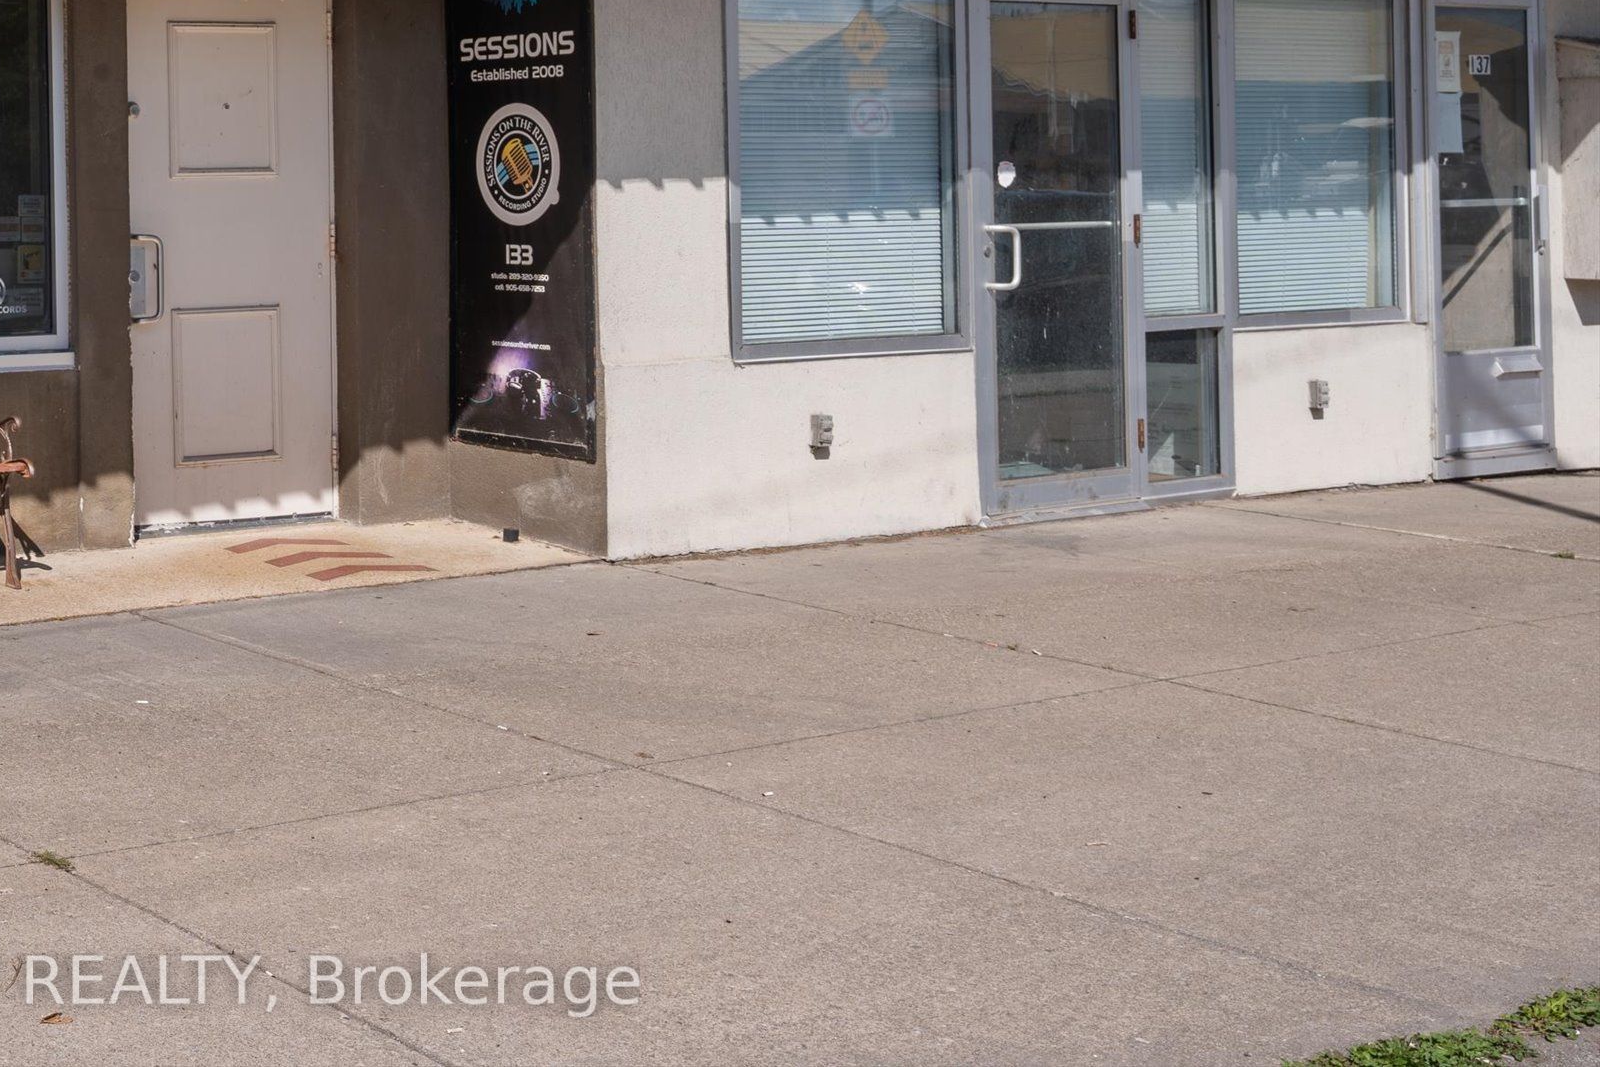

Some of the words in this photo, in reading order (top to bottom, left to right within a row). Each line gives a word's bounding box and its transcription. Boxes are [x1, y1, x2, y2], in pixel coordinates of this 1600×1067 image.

[459, 30, 576, 62] SESSIONS
[470, 66, 529, 82] Established
[531, 64, 565, 79] 2008
[1471, 56, 1489, 73] 137
[485, 130, 501, 187] SESSIONS
[499, 118, 514, 132] ON
[513, 116, 533, 133] THE
[531, 126, 551, 162] RIVER
[498, 194, 532, 211] RECORDING
[530, 177, 547, 204] STUDIO
[505, 243, 534, 266] 133
